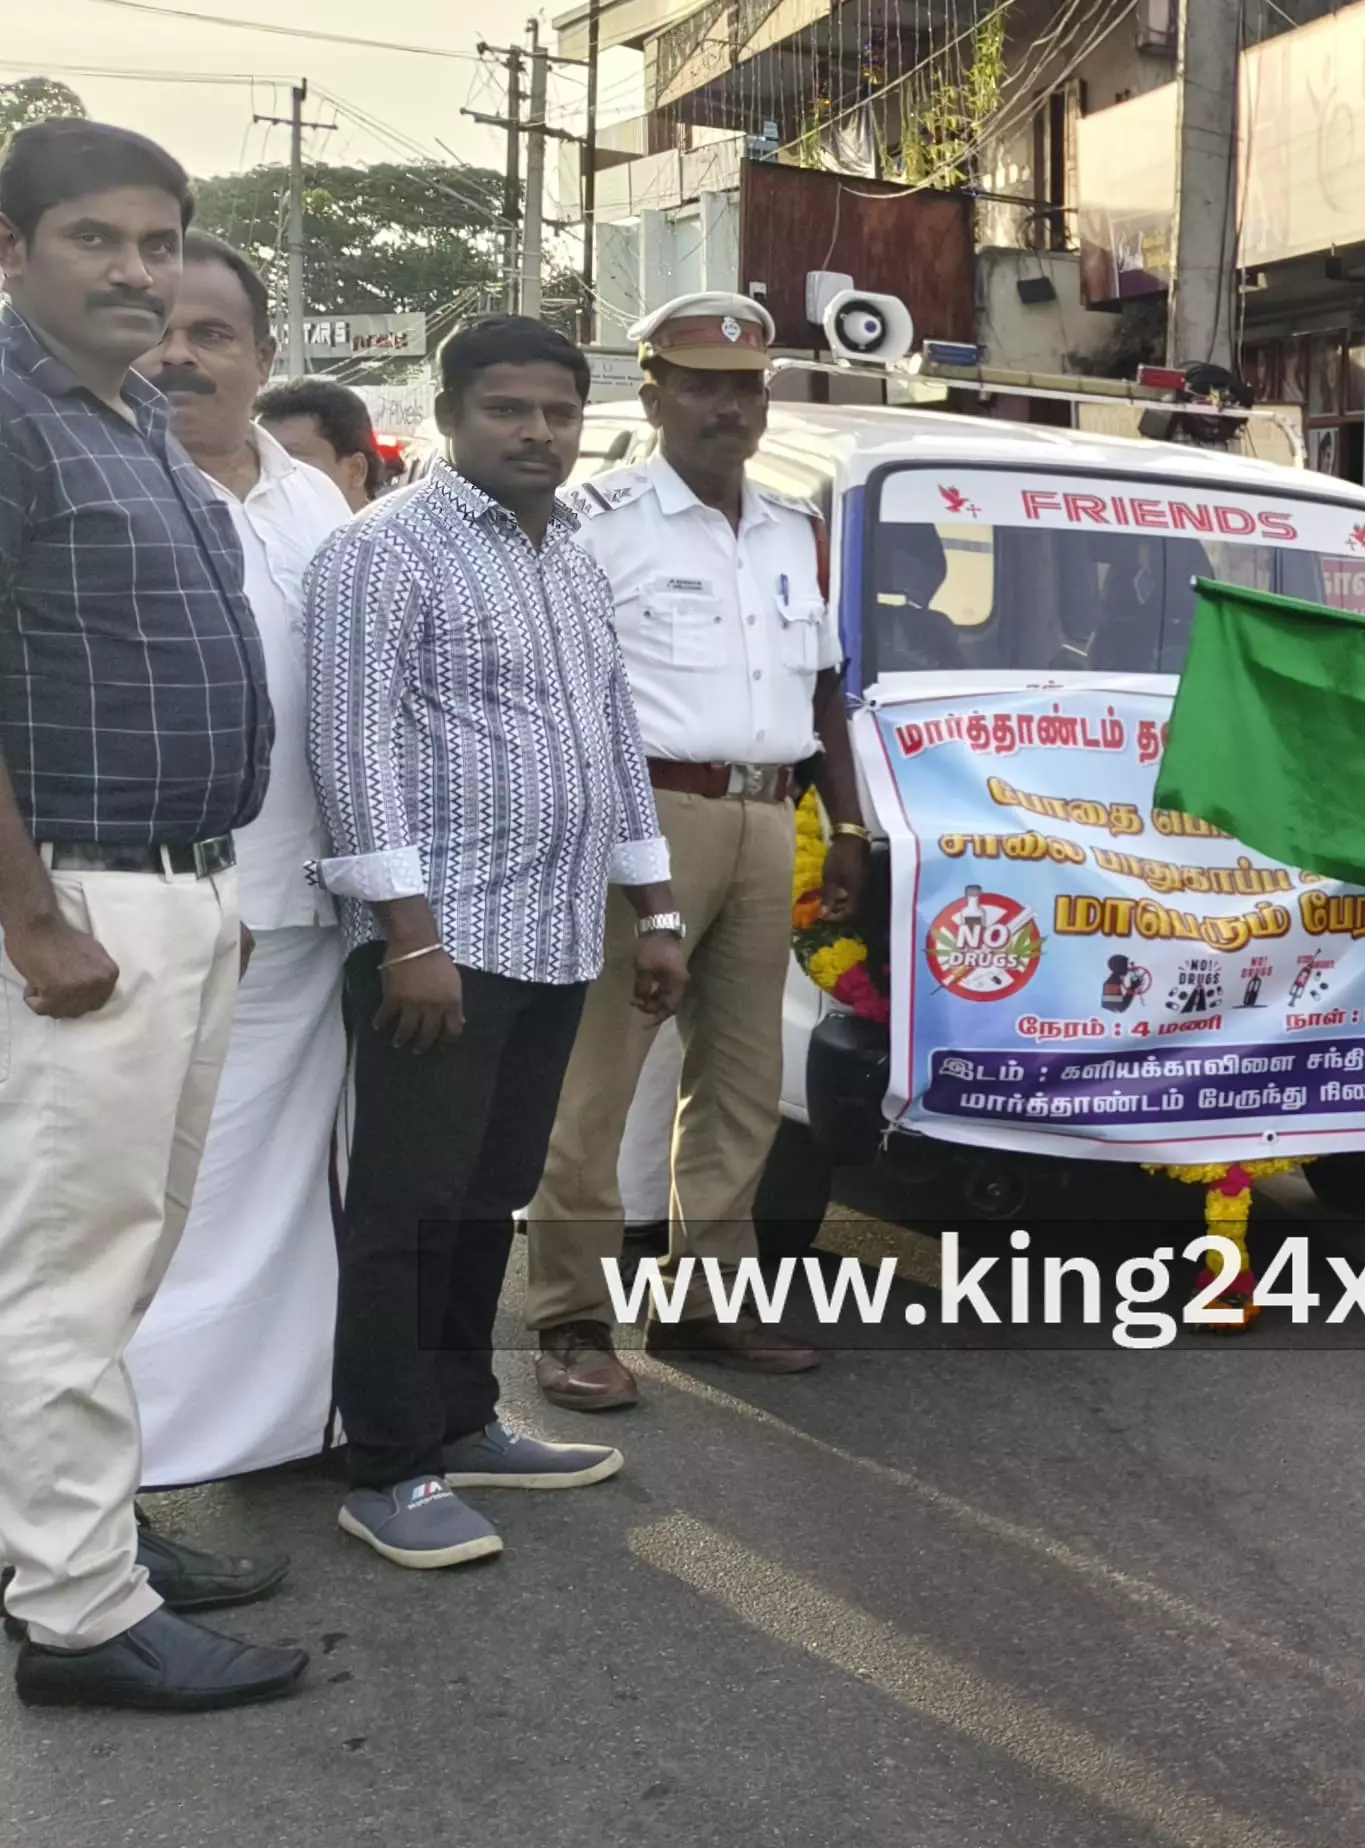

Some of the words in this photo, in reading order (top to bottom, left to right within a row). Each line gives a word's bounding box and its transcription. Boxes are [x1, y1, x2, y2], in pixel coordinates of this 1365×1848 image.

[1021, 490, 1297, 541] FRIENDS
[956, 924, 1010, 950] NO
[949, 952, 1018, 969] DRUGS
[1017, 1016, 1105, 1040] நேரம்
[1131, 1021, 1149, 1037] 4
[1157, 1014, 1223, 1036] மணி
[1285, 1009, 1344, 1032] நாள்
[938, 1057, 1024, 1082] இடம்
[960, 1088, 1184, 1117] மார்த்தாண்டம்
[1198, 1083, 1307, 1111] பேருந்து
